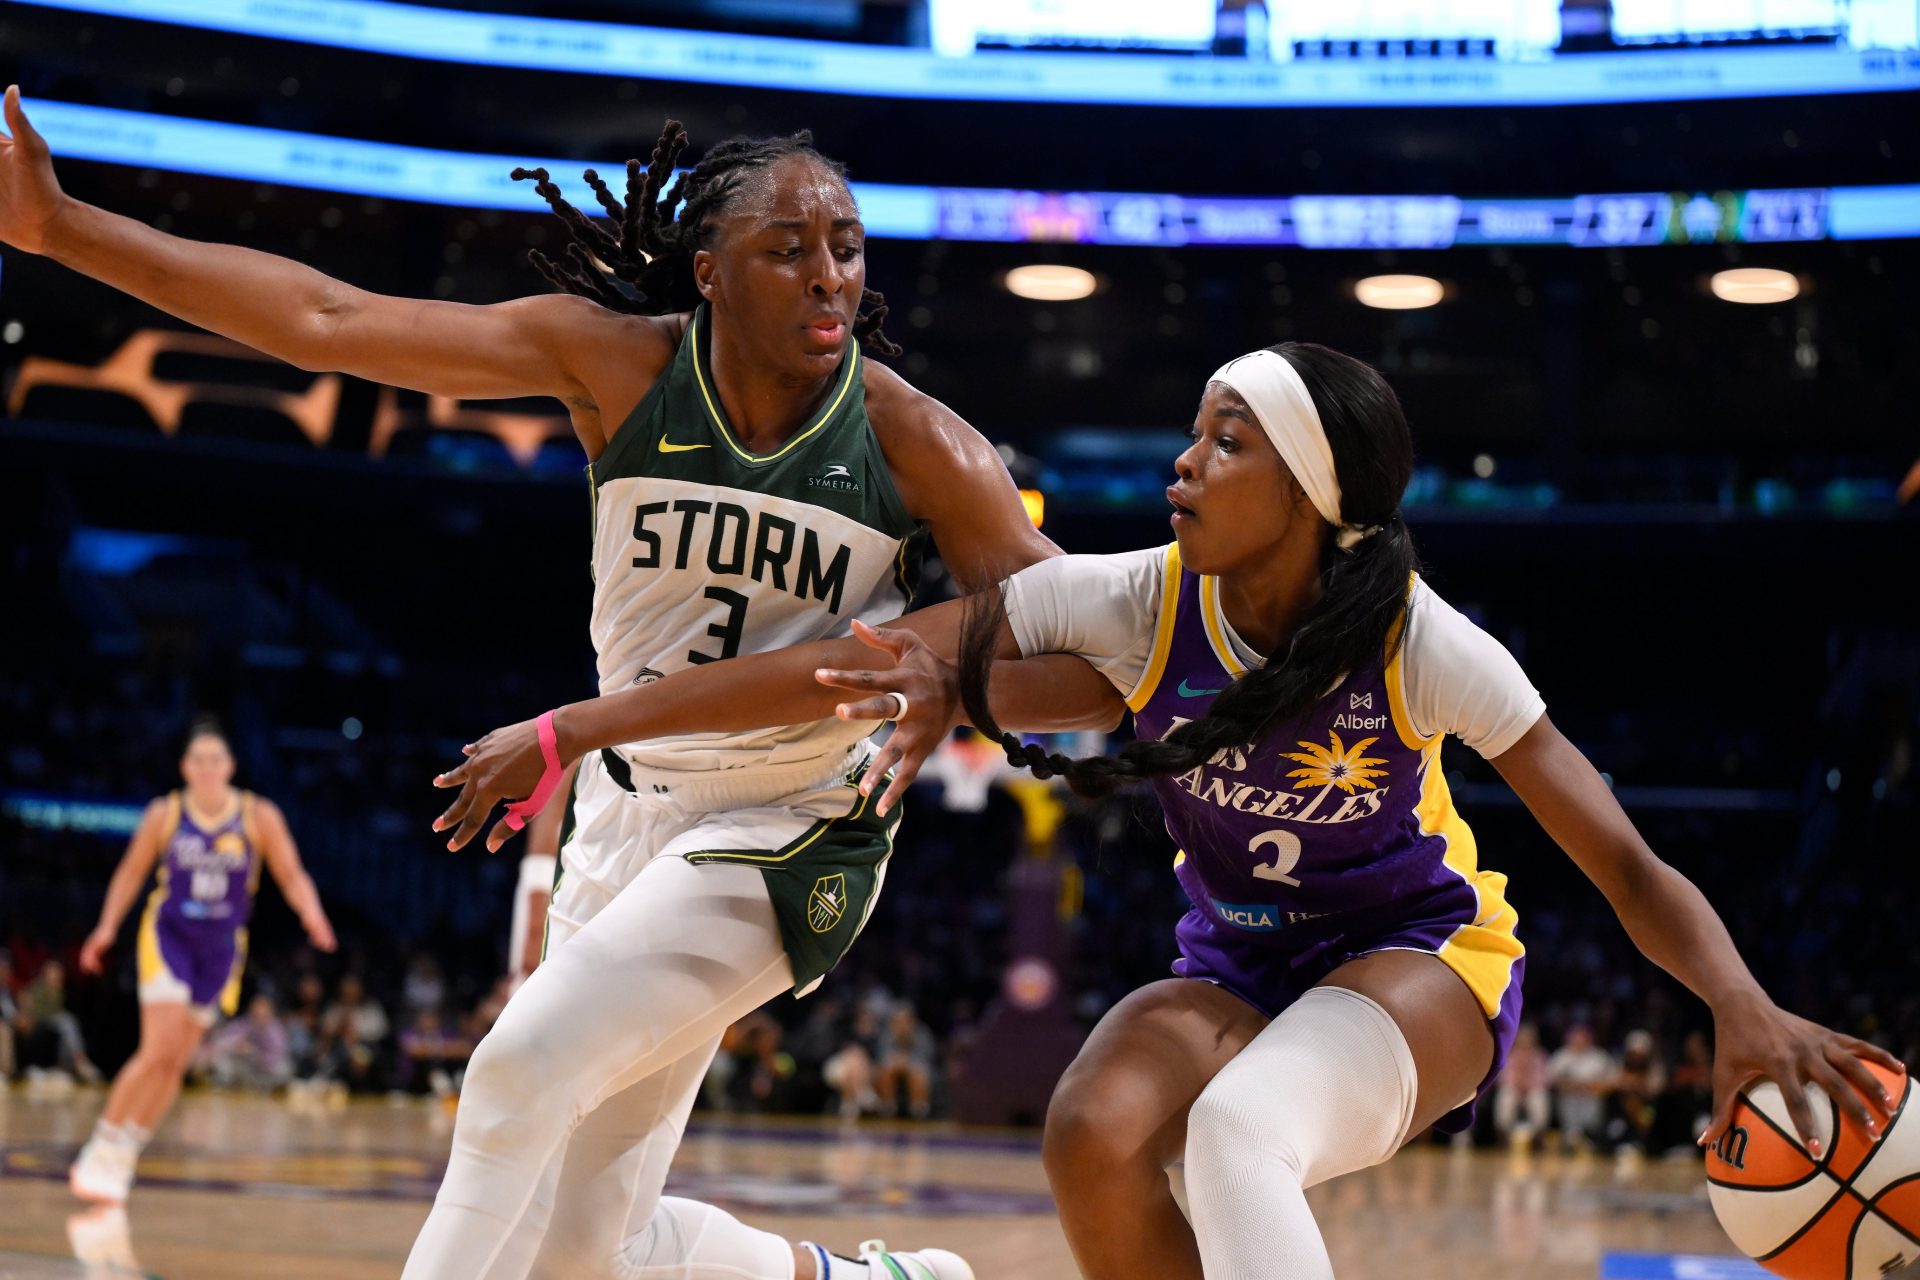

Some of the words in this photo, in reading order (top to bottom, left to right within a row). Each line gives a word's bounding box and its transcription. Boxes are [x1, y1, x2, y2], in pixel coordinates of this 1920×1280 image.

[809, 477, 860, 491] SYMETRA
[632, 500, 851, 615] STORM
[688, 586, 749, 665] 3
[1333, 713, 1388, 730] Albert
[1172, 765, 1390, 824] ANGELES
[1248, 829, 1302, 888] 2
[1221, 907, 1273, 927] UCLA
